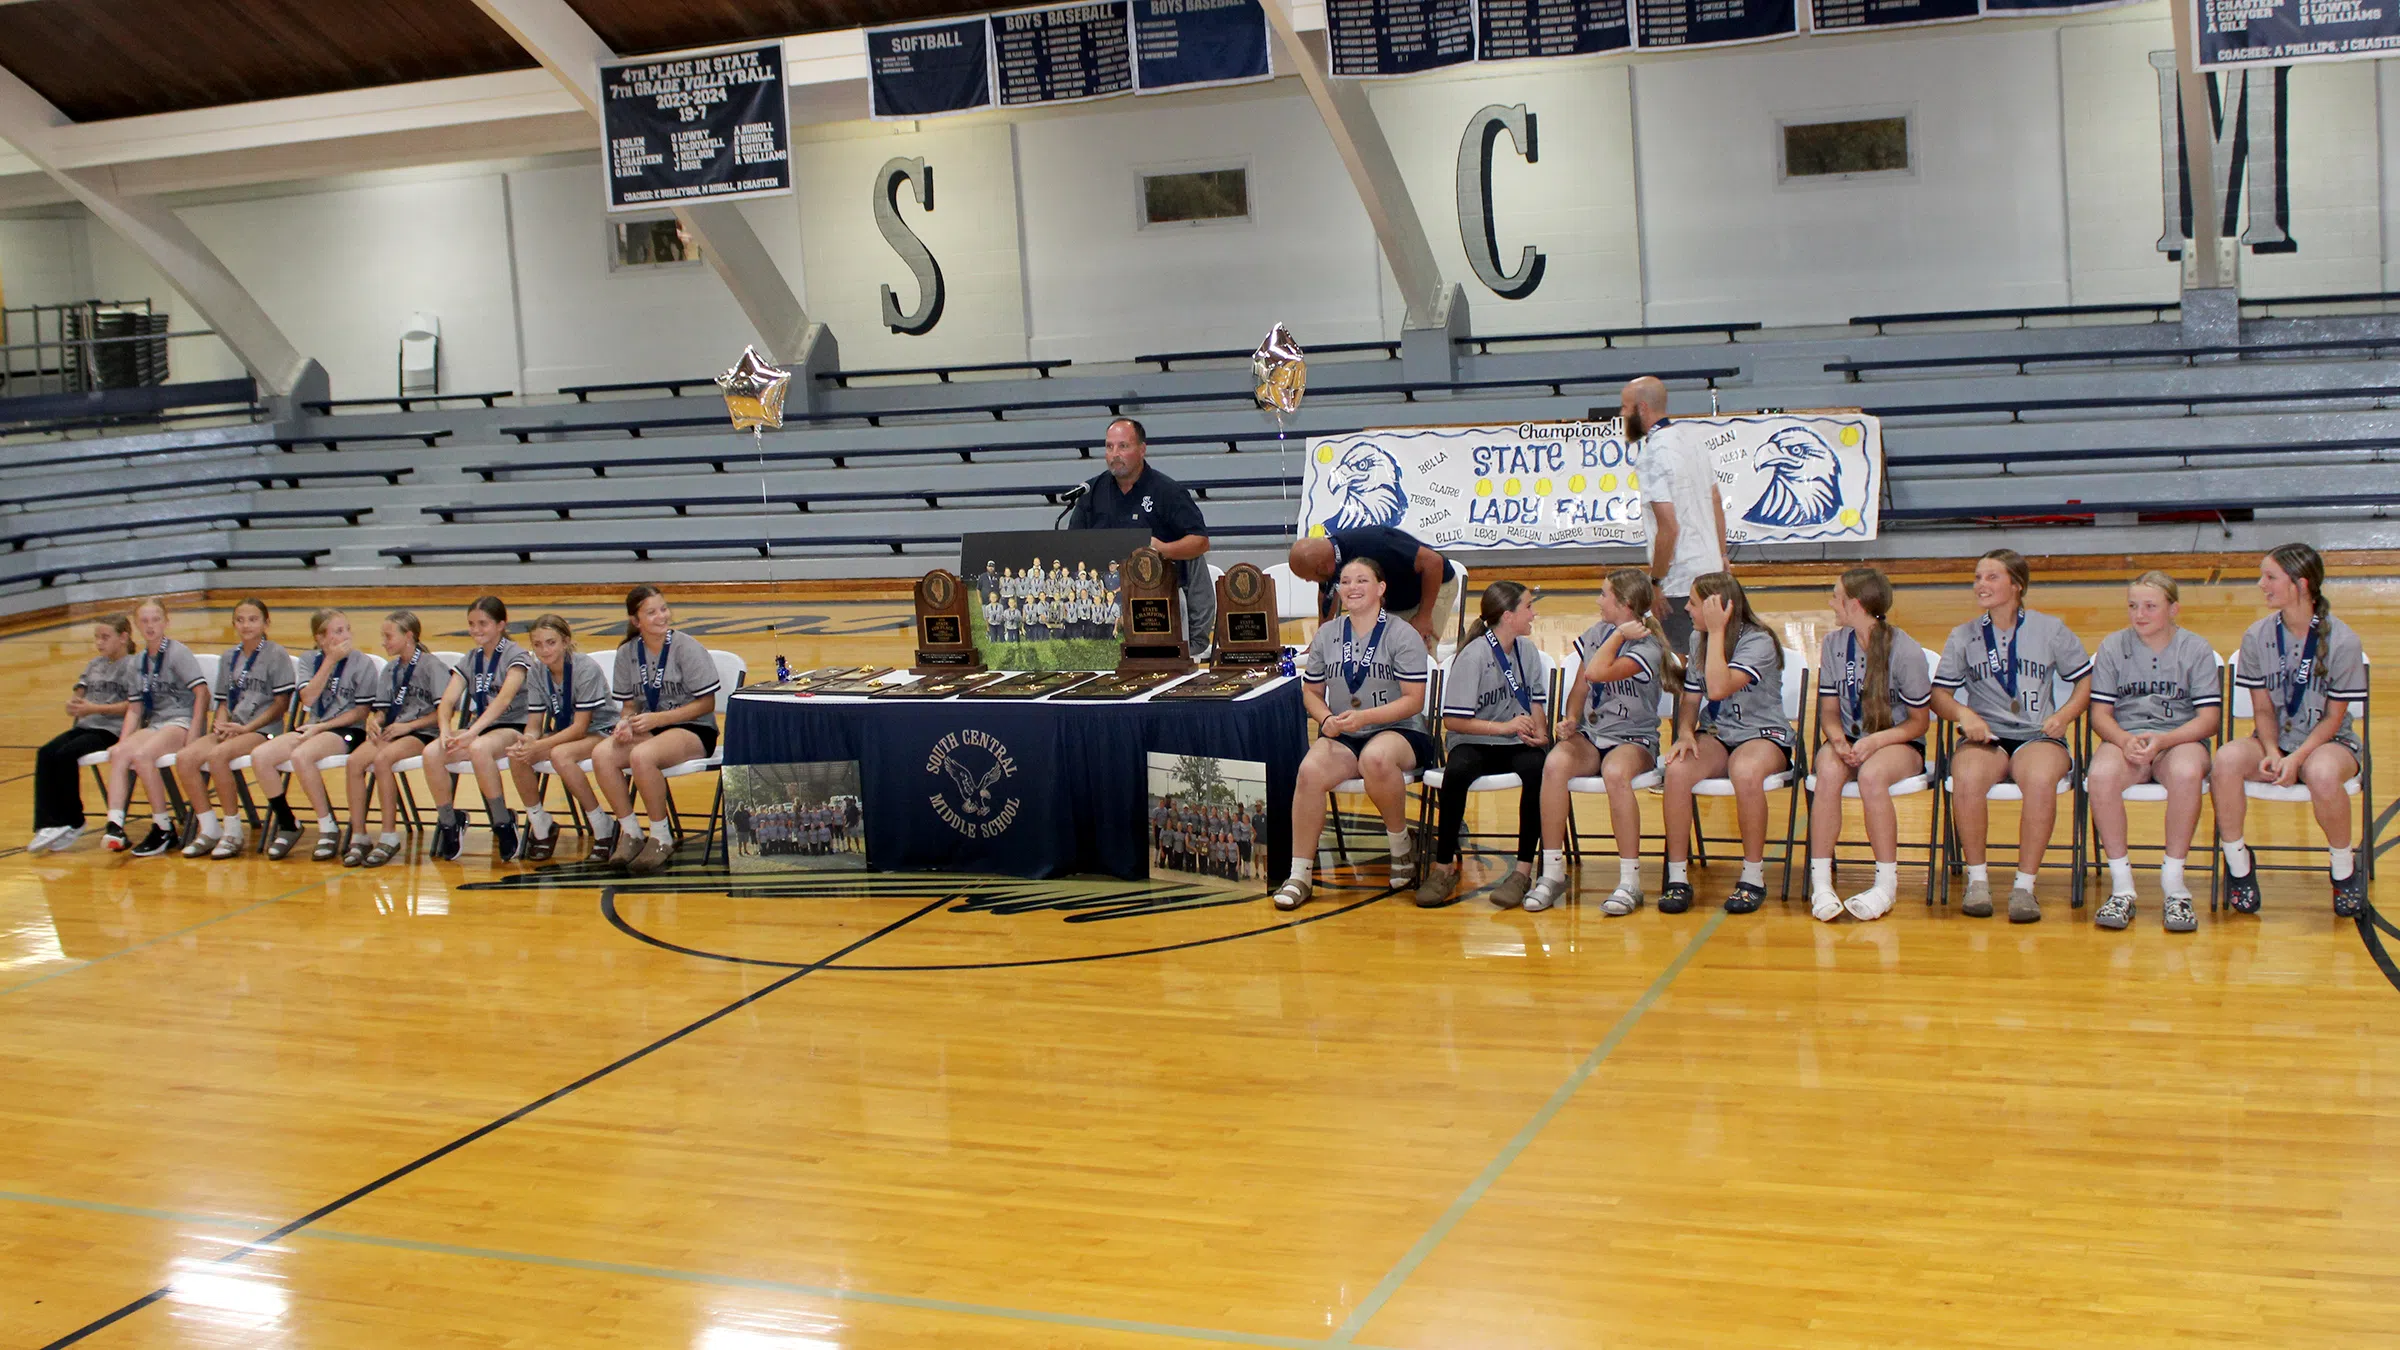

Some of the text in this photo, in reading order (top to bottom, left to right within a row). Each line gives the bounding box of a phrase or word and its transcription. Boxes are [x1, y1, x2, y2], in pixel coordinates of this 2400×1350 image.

[1005, 3, 1115, 31] BOYS BASEBALL
[1151, 0, 1184, 16] BOYS
[2206, 2, 2215, 13] C
[2300, 8, 2382, 26] R WILLIAMS
[2311, 0, 2362, 14] LOWRY
[2206, 13, 2216, 24] T
[2207, 23, 2217, 34] A
[891, 31, 963, 53] SOFTBALL
[2217, 46, 2272, 62] COACHES:
[2274, 45, 2284, 57] A
[2285, 40, 2339, 56] PHILLIPS,
[2340, 40, 2349, 52] J
[622, 52, 760, 83] 4TH PLACE IN STATE
[610, 65, 775, 99] 7TH GRADE VOLLEYBALL
[656, 87, 728, 110] 2023-2024
[679, 105, 707, 122] 19-7
[677, 129, 710, 142] LOWRY
[673, 152, 679, 162] J
[674, 162, 680, 172] J
[742, 150, 787, 164] WILLIAMS
[873, 156, 944, 336] S
[1456, 103, 1546, 300] C
[1518, 417, 1623, 442] Champions!!
[1418, 451, 1448, 475] BELLA
[1472, 441, 1565, 477] STATE
[1429, 482, 1460, 498] CLAIRE
[1410, 493, 1437, 509] TESSA
[1468, 497, 1542, 525] LADY
[1435, 528, 1465, 543] ELLIE
[1506, 526, 1543, 542] RAELYN
[1549, 527, 1584, 543] AUBREE
[1593, 526, 1625, 539] VIOLET
[1486, 629, 1498, 648] IESA
[1361, 646, 1375, 667] IESA
[1504, 670, 1519, 691] IESA
[1846, 661, 1855, 686] IESA
[1371, 690, 1387, 708] 15
[1477, 686, 1507, 711] SOUTH
[2022, 691, 2039, 712] 12
[1732, 703, 1742, 720] 9
[2161, 700, 2173, 718] 8
[926, 729, 1018, 778] SOUTH CENTRAL
[929, 793, 1020, 839] MIDDLE SCHOOL
